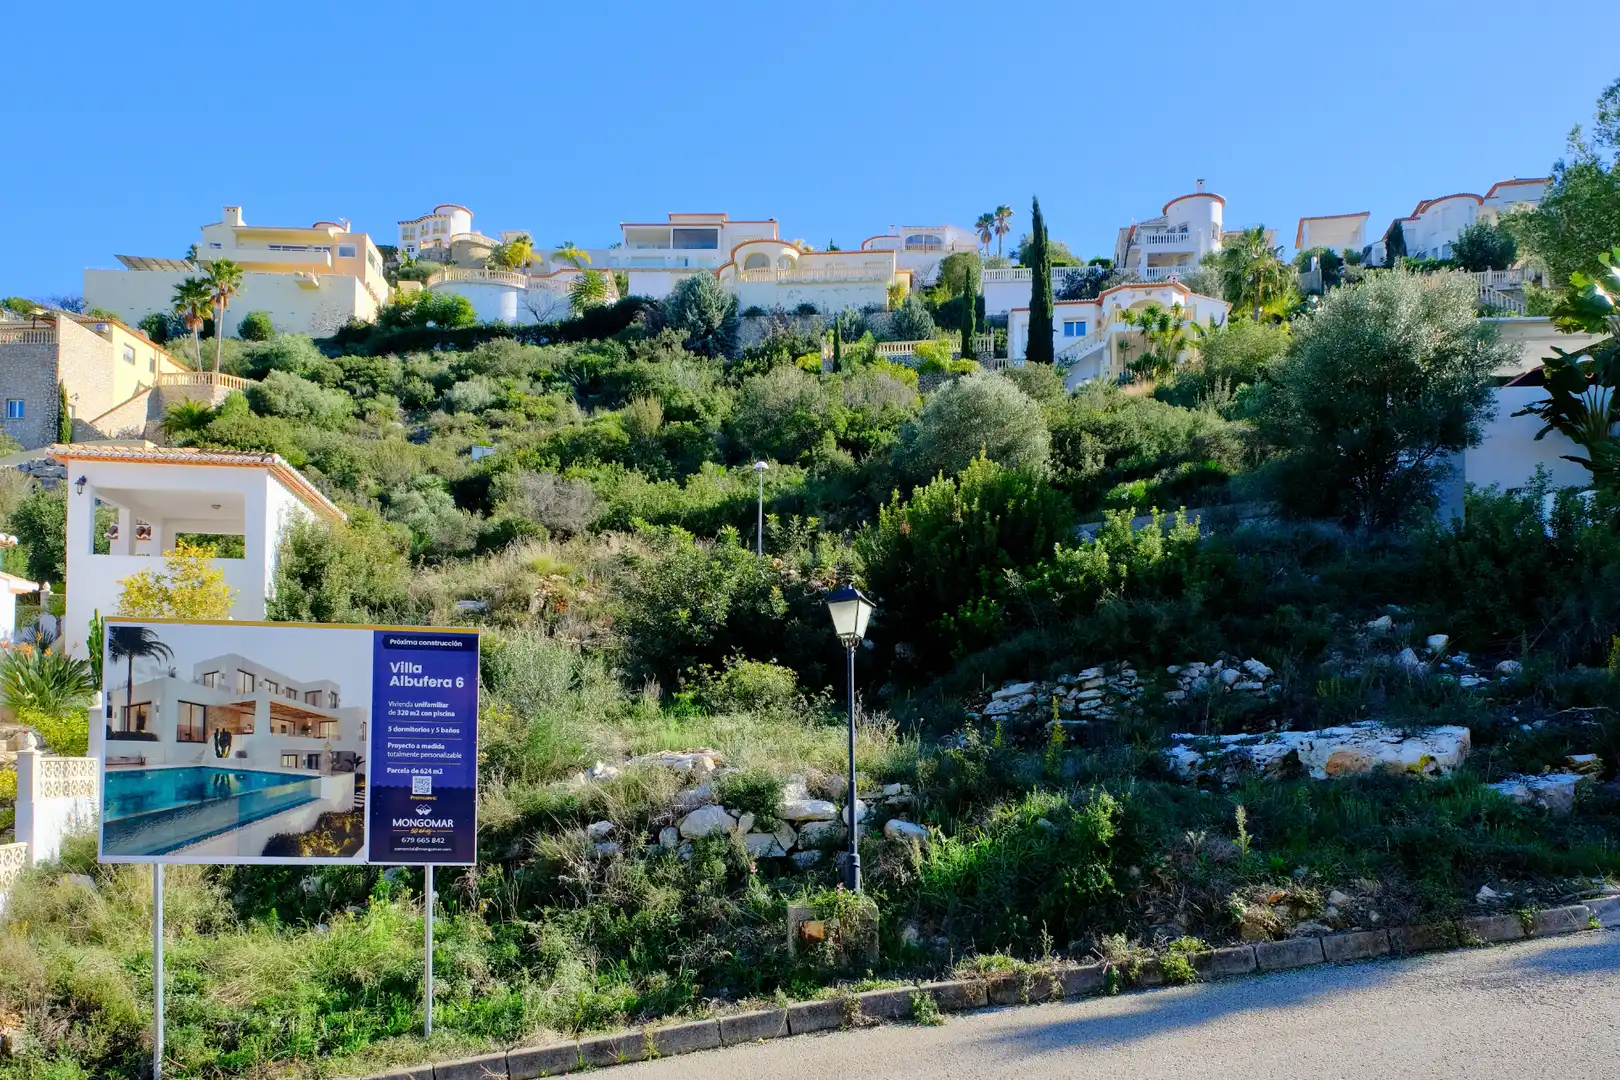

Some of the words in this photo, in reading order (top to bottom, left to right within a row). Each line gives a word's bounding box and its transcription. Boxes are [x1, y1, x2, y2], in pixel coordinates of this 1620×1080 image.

[390, 661, 422, 673] Villa
[389, 676, 452, 687] Albufera
[456, 677, 464, 688] 6
[393, 818, 453, 827] MONGOMAR
